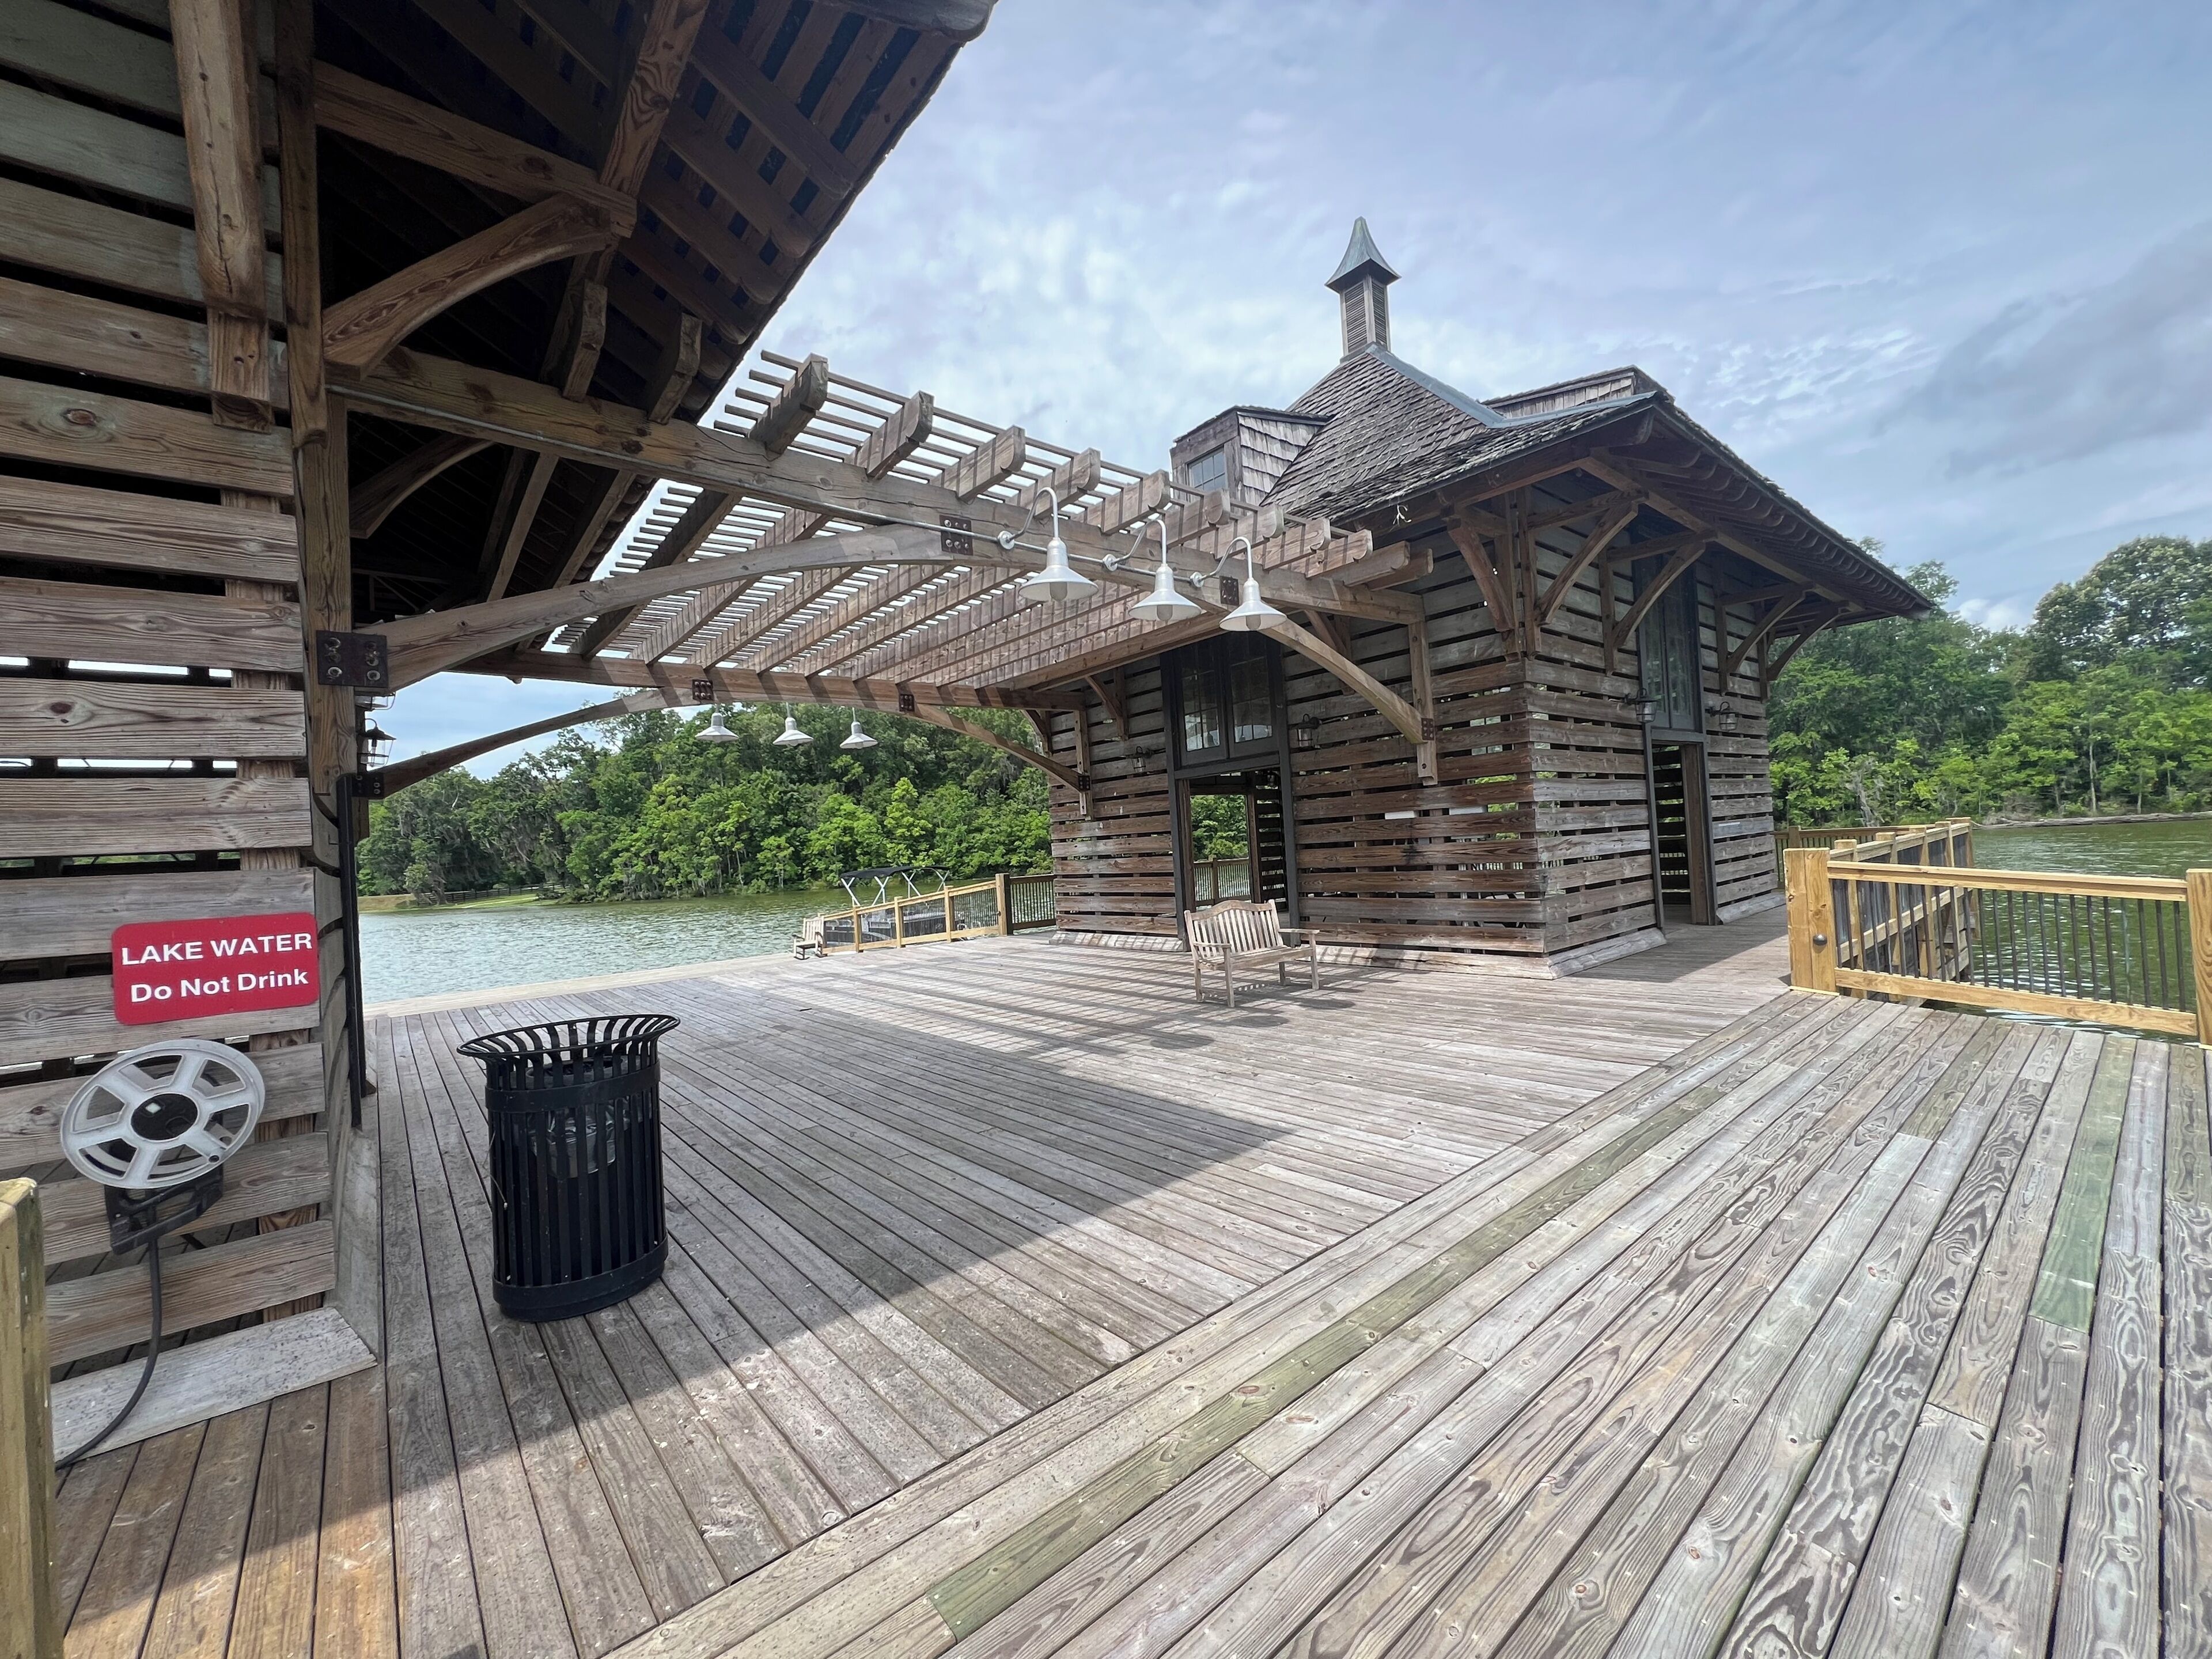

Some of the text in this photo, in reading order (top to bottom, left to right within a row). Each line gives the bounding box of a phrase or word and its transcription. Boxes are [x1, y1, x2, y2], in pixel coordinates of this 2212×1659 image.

[122, 933, 312, 965] LAKE WATER
[131, 968, 309, 1002] Do Not Drink
